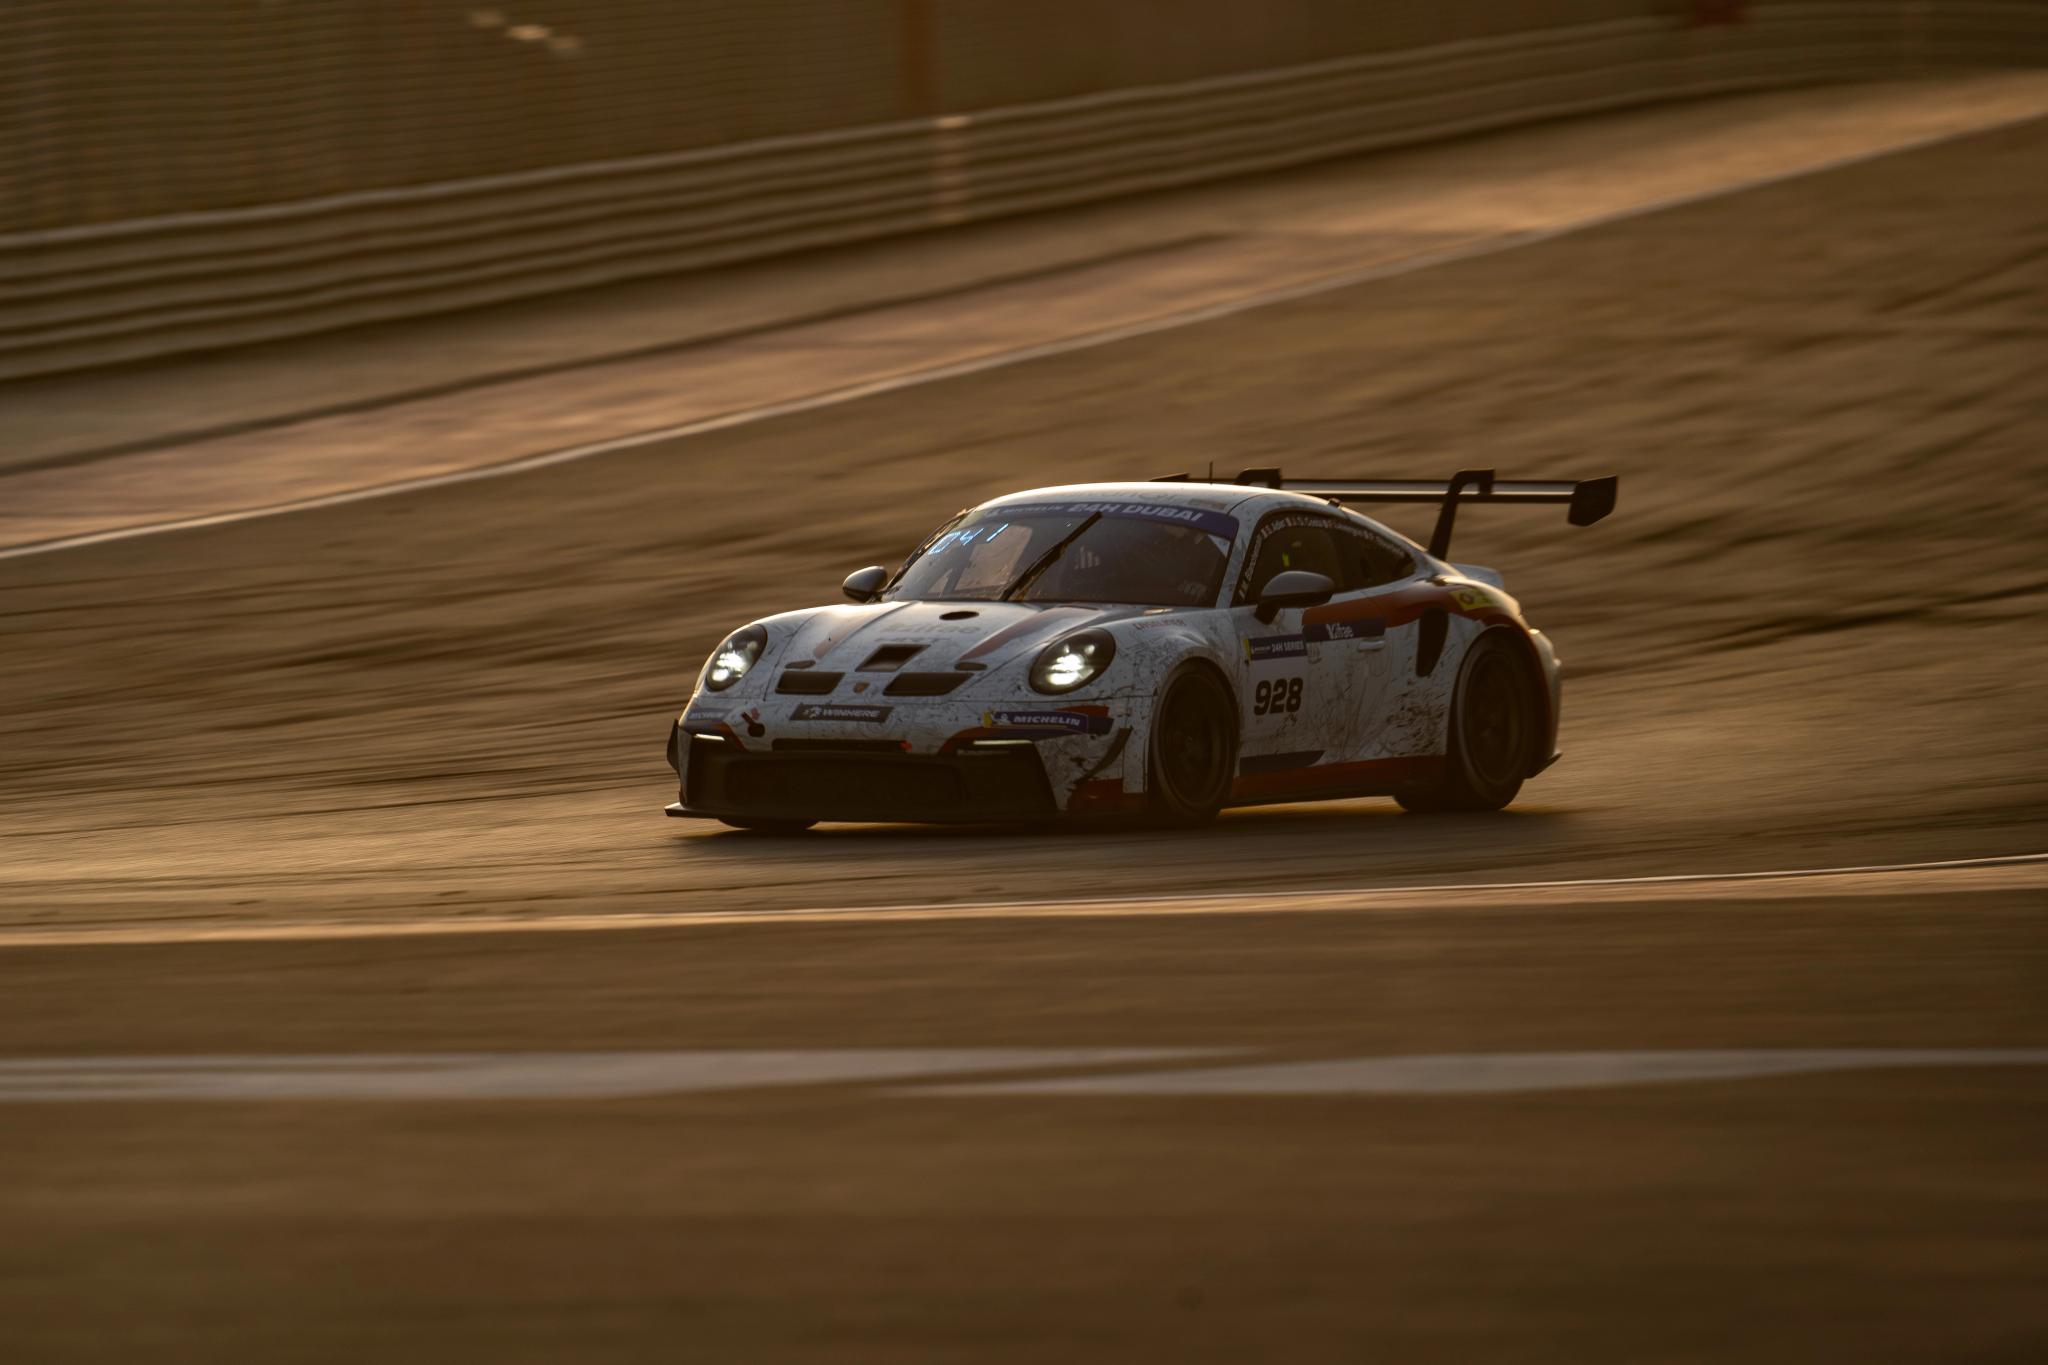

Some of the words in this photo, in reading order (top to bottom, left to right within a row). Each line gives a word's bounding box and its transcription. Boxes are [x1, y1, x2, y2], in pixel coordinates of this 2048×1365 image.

[1066, 503, 1121, 513] 24H
[1121, 504, 1204, 522] DUBAI
[1254, 677, 1303, 716] 928
[1013, 715, 1080, 726] MICHELIN
